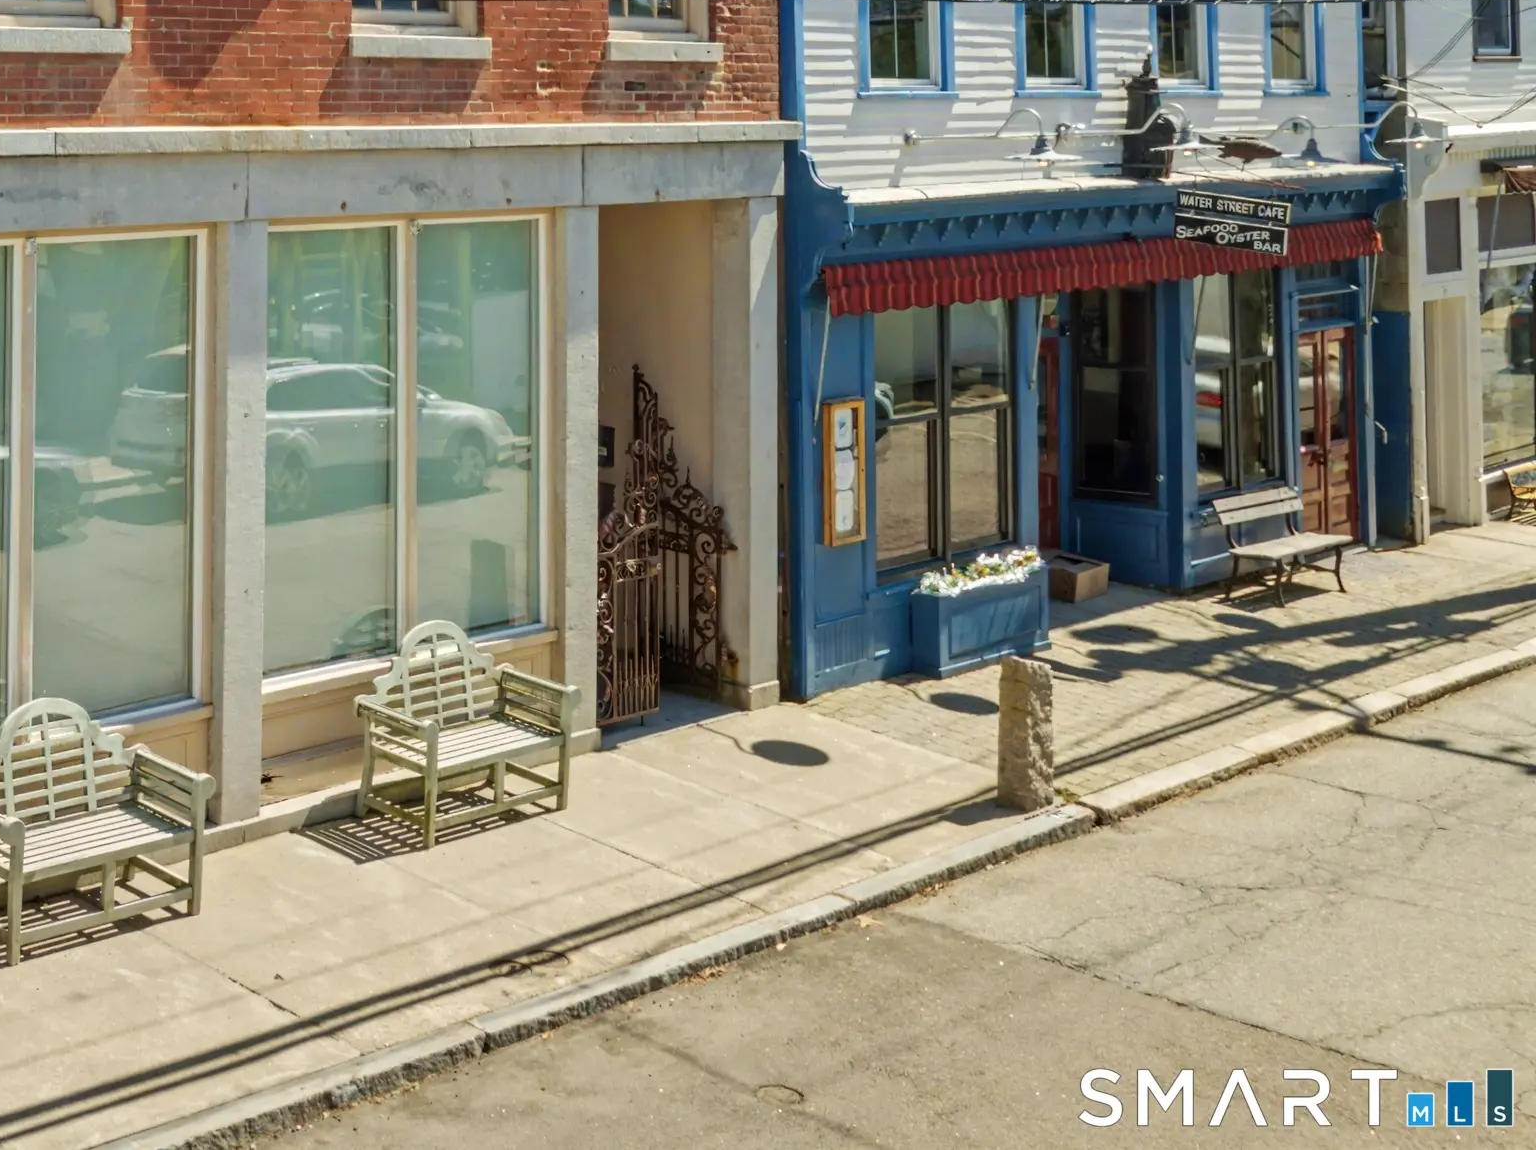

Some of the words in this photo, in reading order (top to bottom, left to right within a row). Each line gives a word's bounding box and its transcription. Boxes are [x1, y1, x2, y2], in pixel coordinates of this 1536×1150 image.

[1179, 193, 1213, 209] WATER
[1216, 199, 1255, 215] STREET
[1257, 204, 1285, 220] CAFE
[1175, 223, 1239, 239] SEAFOOD
[1216, 230, 1270, 244] OYSTER
[1253, 240, 1282, 254] BAR
